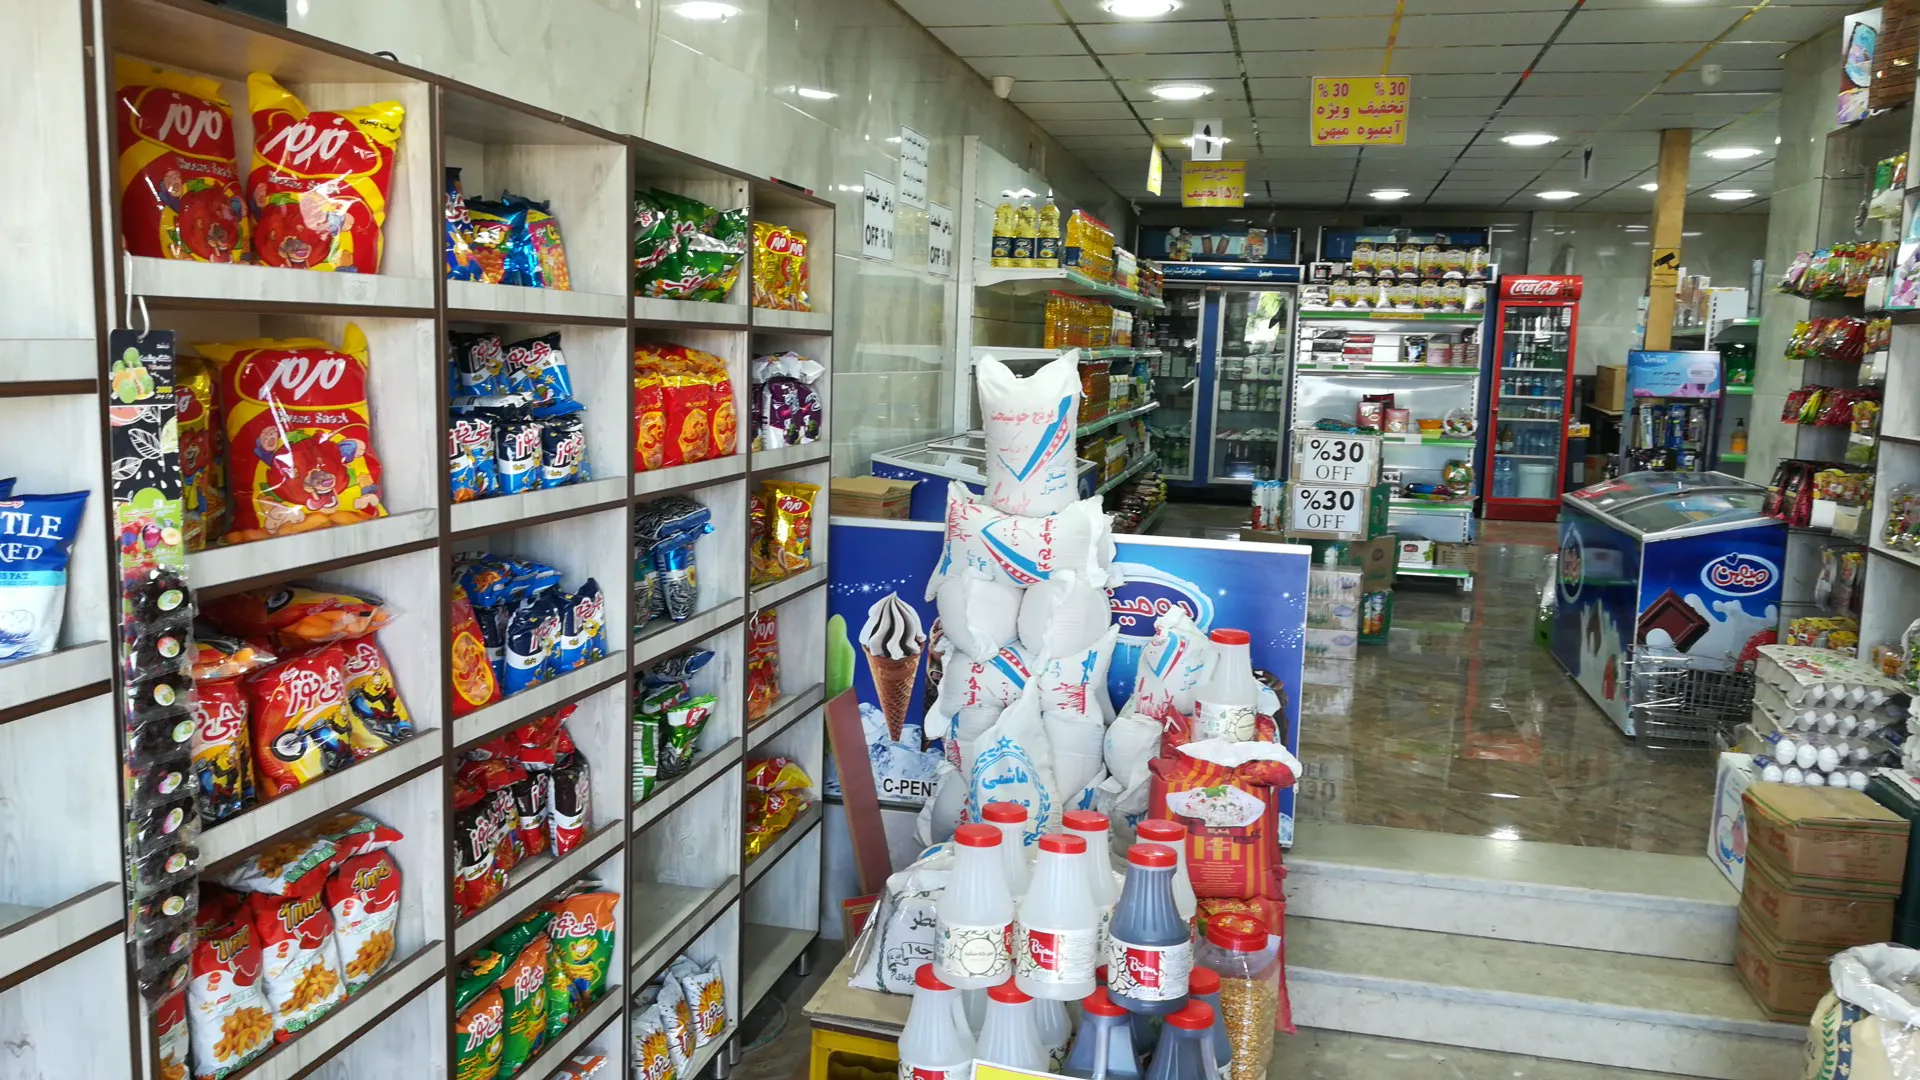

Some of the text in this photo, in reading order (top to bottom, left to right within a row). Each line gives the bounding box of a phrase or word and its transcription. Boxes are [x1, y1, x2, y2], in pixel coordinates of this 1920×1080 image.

[1317, 100, 1405, 120] تخفیف ویژه
[1317, 120, 1402, 141] آبمیوه میهن
[865, 223, 879, 247] OFF
[1310, 439, 1364, 463] %30
[1316, 464, 1355, 481] OFF
[1300, 489, 1355, 511] %30
[1306, 513, 1346, 529] OFF
[981, 766, 1029, 790] هاشمی
[1031, 938, 1058, 964] Bijan
[1128, 956, 1159, 981] Bijan
